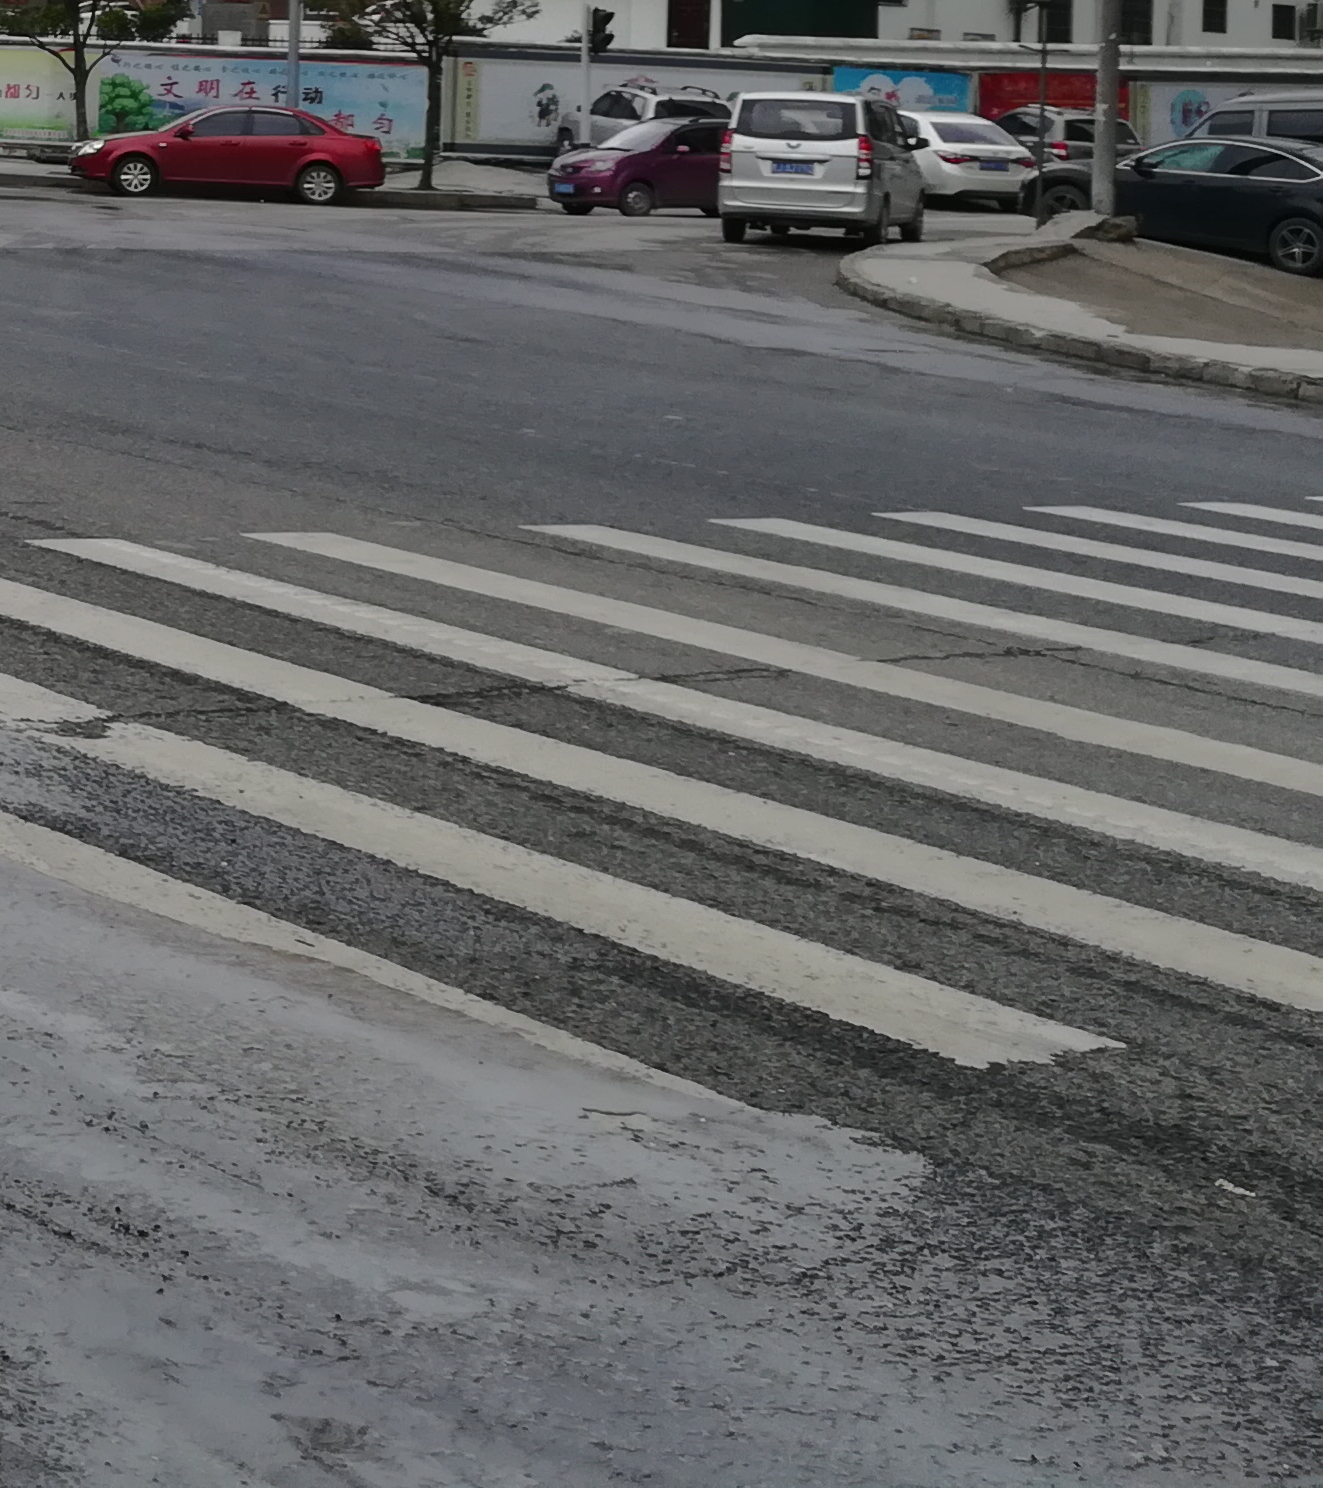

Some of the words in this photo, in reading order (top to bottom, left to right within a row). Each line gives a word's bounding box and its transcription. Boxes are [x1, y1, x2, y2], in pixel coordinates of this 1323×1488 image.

[157, 75, 324, 106] 文明在行动
